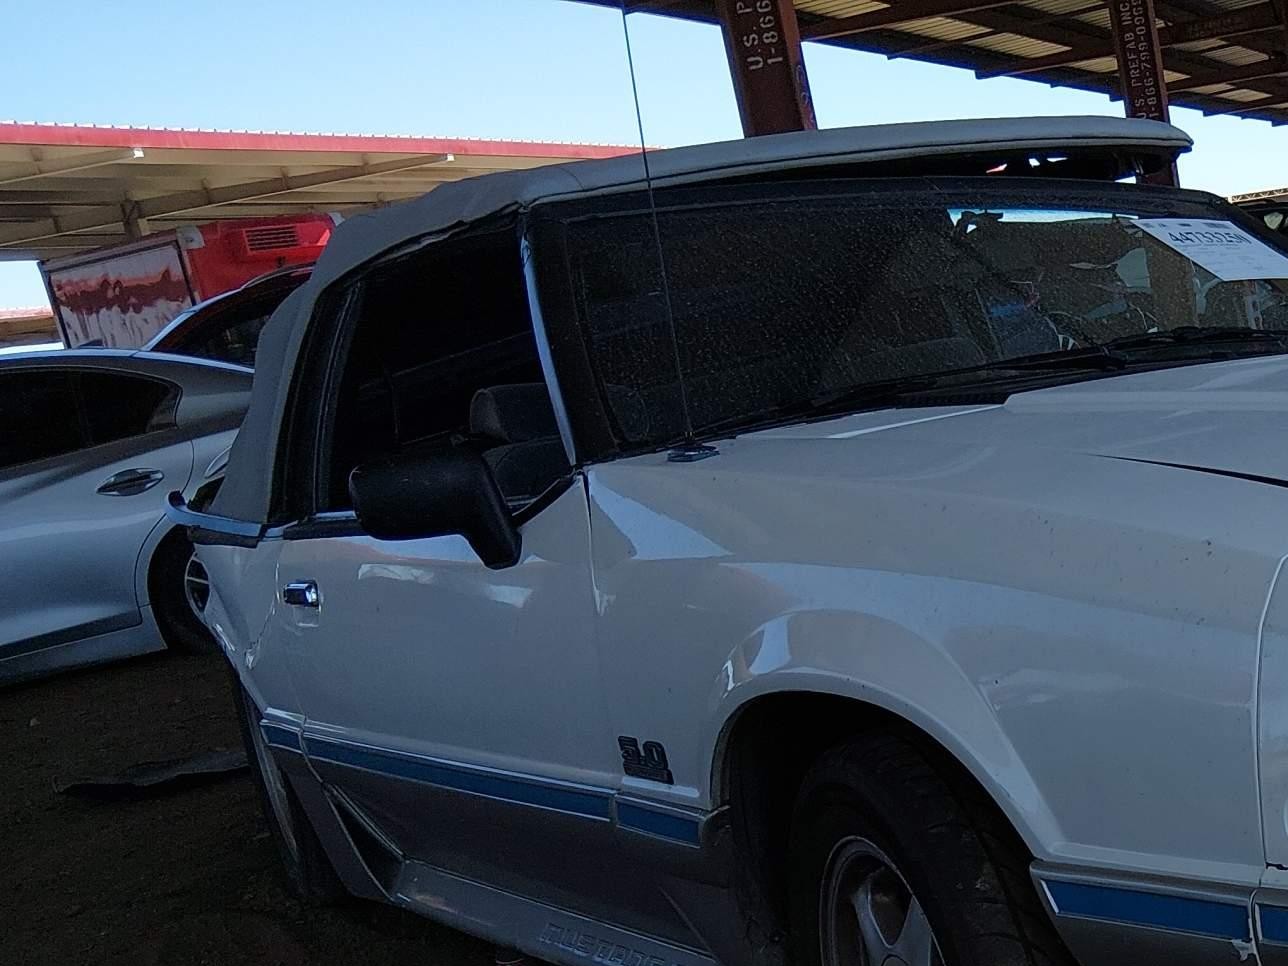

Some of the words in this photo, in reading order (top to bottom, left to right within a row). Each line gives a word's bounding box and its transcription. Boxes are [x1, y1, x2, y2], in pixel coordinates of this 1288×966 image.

[743, 26, 764, 70] U.S.
[1124, 32, 1143, 87] PREFAB
[618, 735, 669, 770] 5.0
